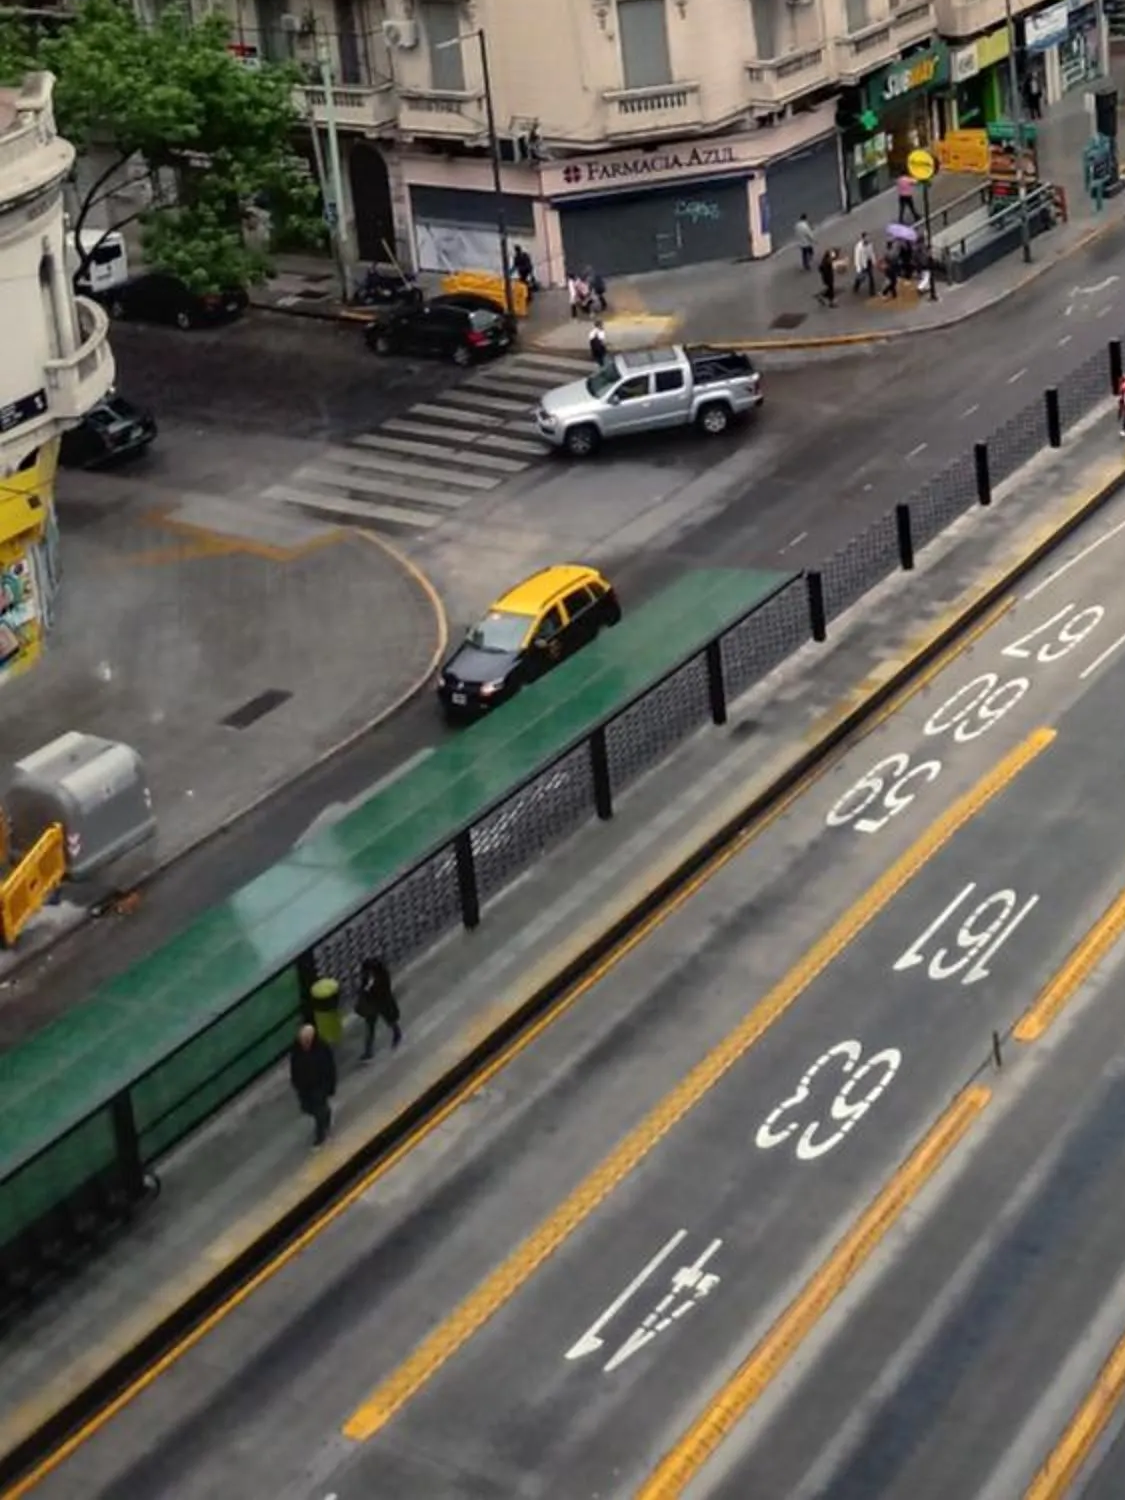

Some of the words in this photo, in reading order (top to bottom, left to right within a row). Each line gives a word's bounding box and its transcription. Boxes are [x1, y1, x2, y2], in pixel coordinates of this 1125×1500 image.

[586, 154, 683, 181] FARMACIA
[685, 146, 737, 167] AZUL
[1001, 602, 1105, 663] 67
[923, 672, 1030, 743] 60
[826, 752, 941, 834] 59
[893, 882, 1040, 986] 161
[755, 1040, 902, 1161] 63
[563, 1228, 721, 1373] 41
